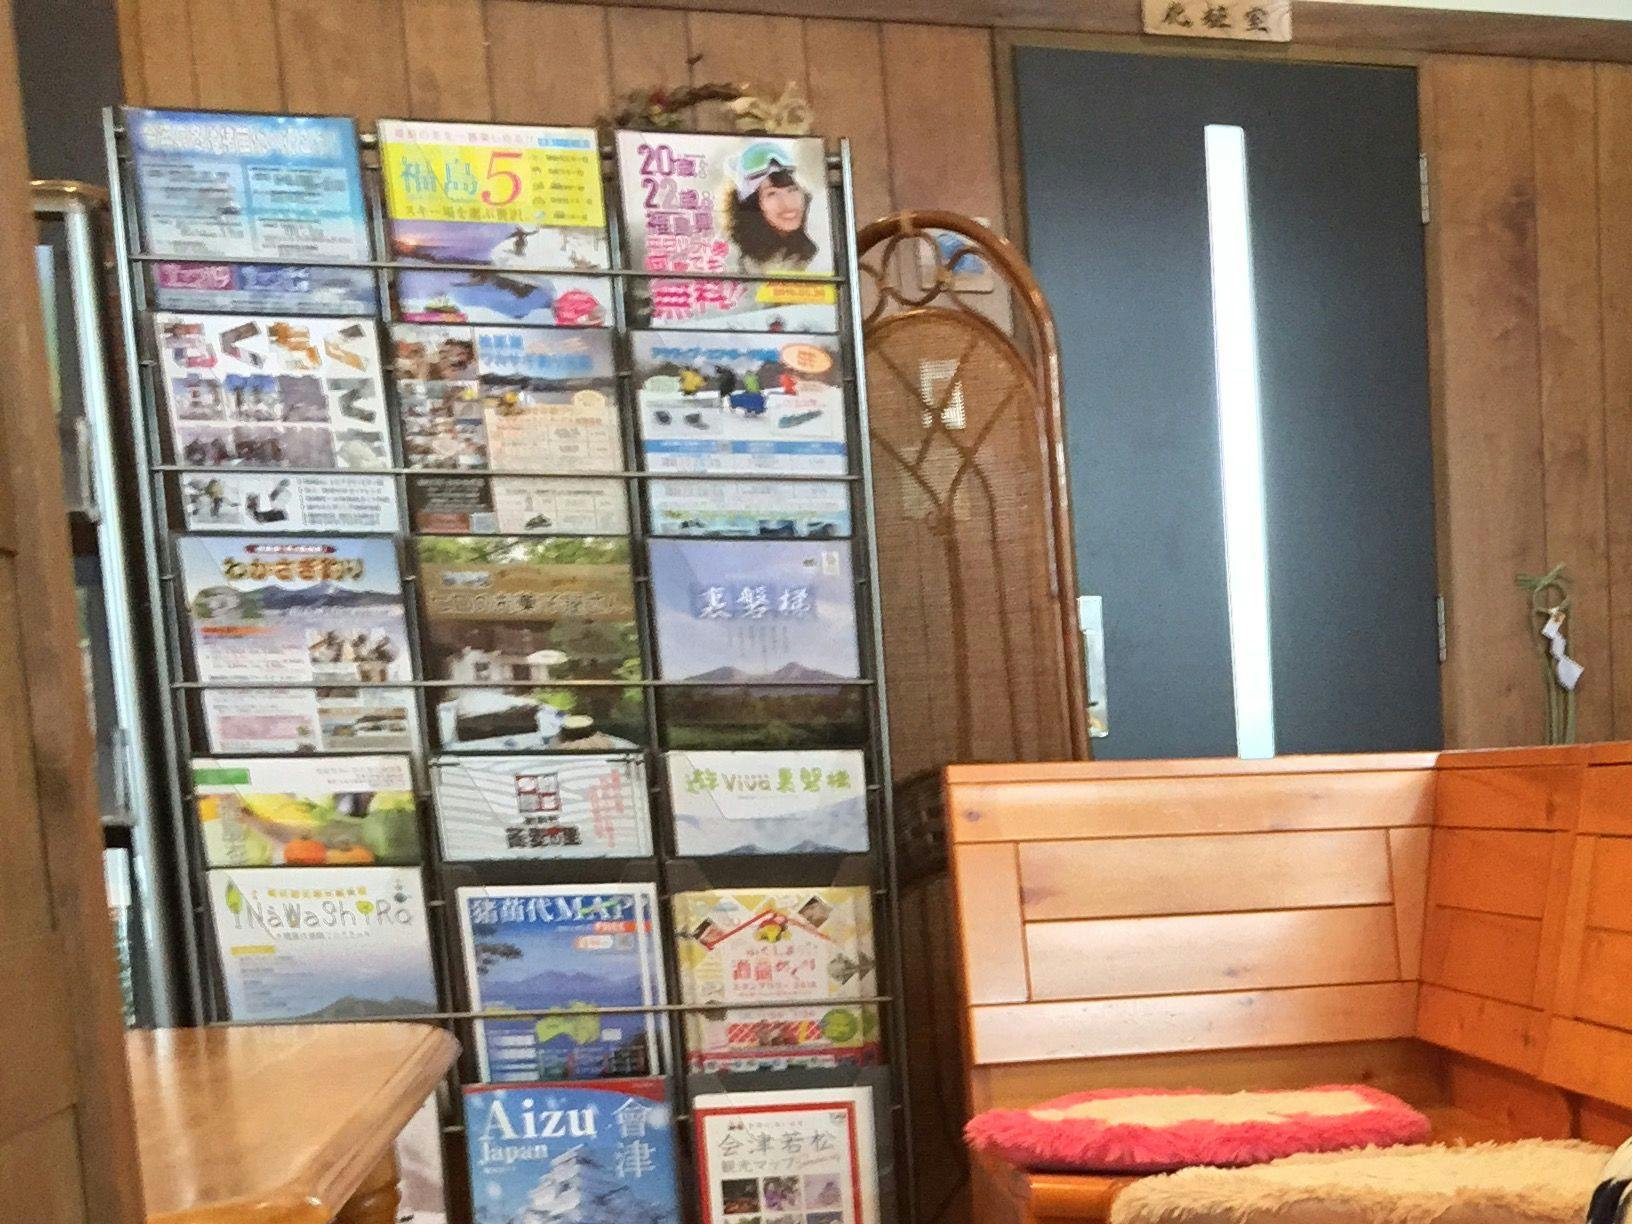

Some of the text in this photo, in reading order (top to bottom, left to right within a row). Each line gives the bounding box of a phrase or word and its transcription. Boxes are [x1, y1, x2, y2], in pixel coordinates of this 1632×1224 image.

[478, 1097, 598, 1141] Aizu
[478, 1142, 549, 1166] Japan
[717, 1128, 838, 1158] 会津若松
